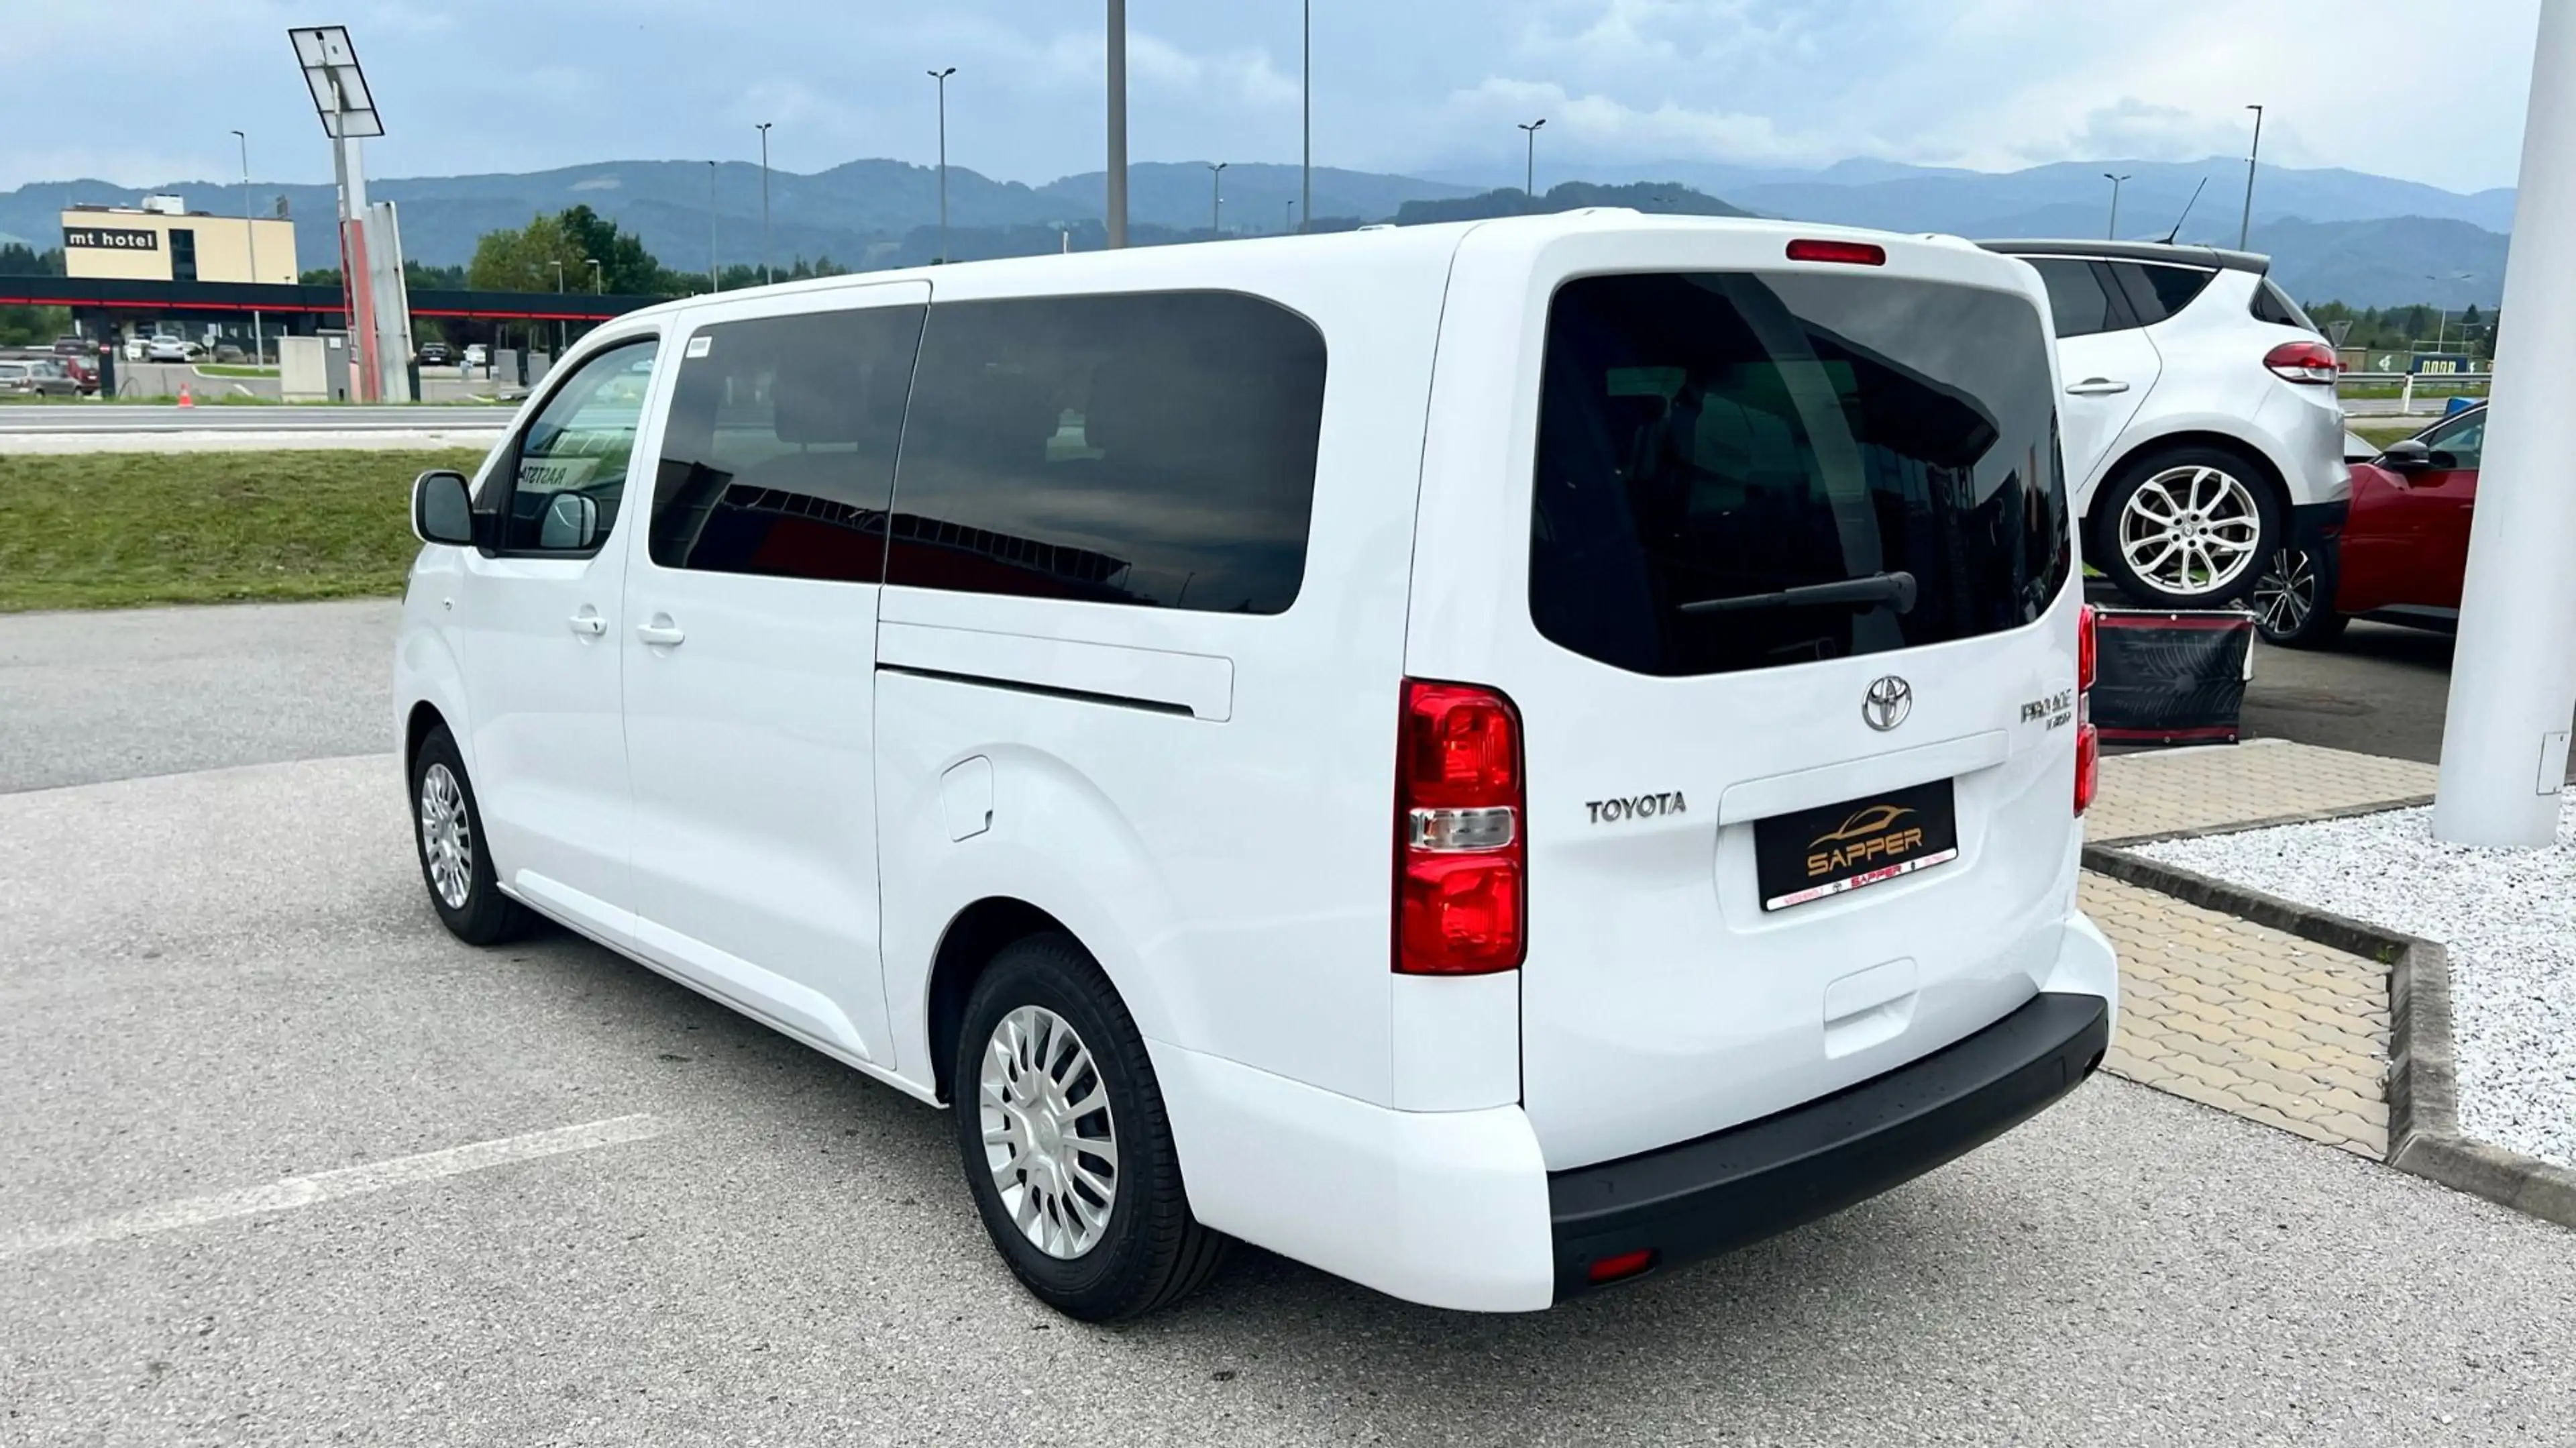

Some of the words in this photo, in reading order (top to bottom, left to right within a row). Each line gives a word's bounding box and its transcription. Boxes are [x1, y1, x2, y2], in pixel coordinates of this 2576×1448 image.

[70, 232, 95, 246] mt
[102, 231, 153, 247] hotel
[1585, 790, 1686, 824] TOYOTA
[1807, 827, 1923, 877] SAPPER
[1849, 865, 1902, 888] SAPPER
